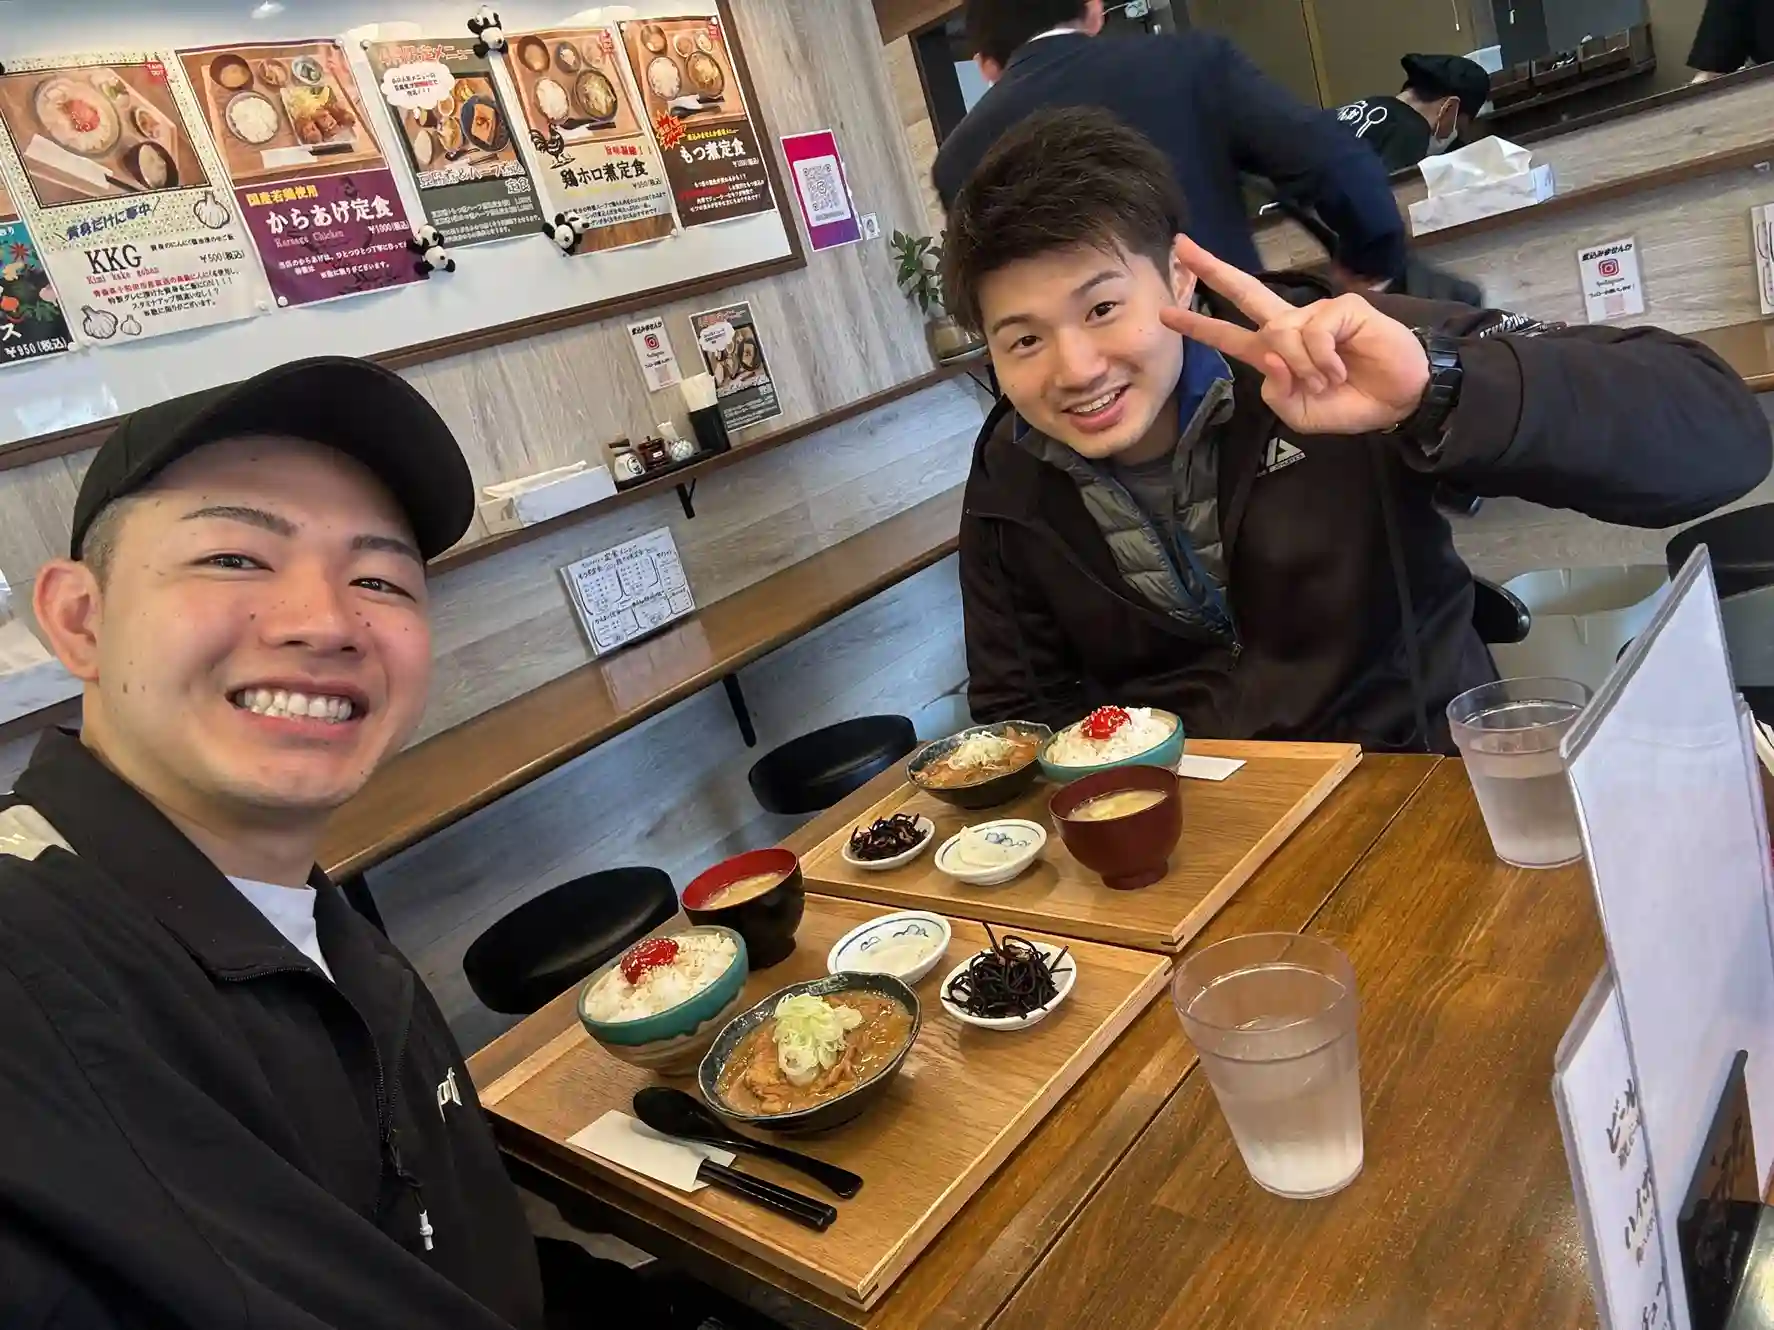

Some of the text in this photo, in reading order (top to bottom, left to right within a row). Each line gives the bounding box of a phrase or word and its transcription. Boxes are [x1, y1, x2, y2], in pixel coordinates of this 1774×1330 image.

[680, 137, 746, 163] もつ煮定食
[266, 195, 393, 234] からあげ定食
[84, 244, 142, 274] KKG
[200, 249, 245, 264] ¥500(税込)
[86, 275, 107, 285] Kimi
[4, 337, 67, 358] ¥950(税込)
